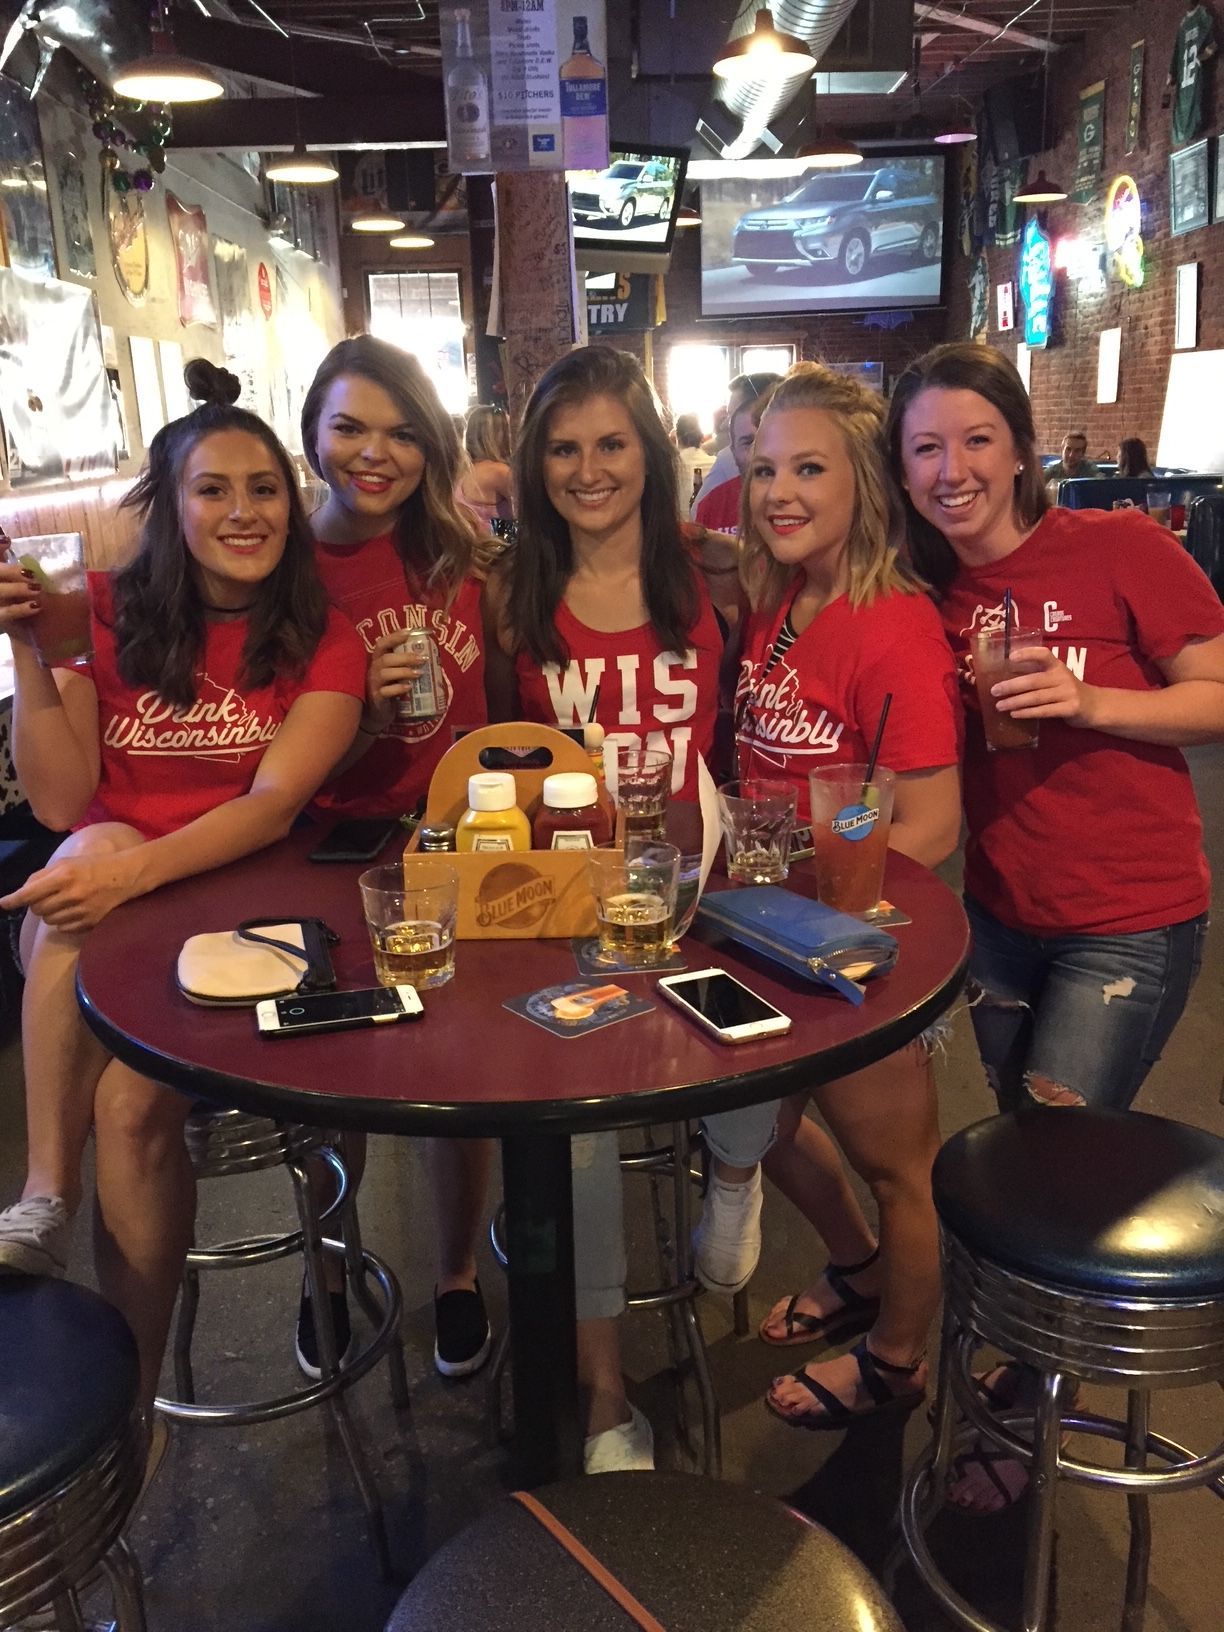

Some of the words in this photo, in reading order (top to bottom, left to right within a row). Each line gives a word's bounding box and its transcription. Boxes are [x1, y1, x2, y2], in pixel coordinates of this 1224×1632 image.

[1181, 44, 1200, 88] 12
[515, 89, 554, 99] PITCHERS
[1084, 124, 1095, 142] G
[542, 649, 698, 726] WIS
[832, 819, 855, 833] BLUE
[856, 810, 878, 825] MOON
[476, 898, 515, 928] BLUE
[516, 879, 553, 908] MOON
